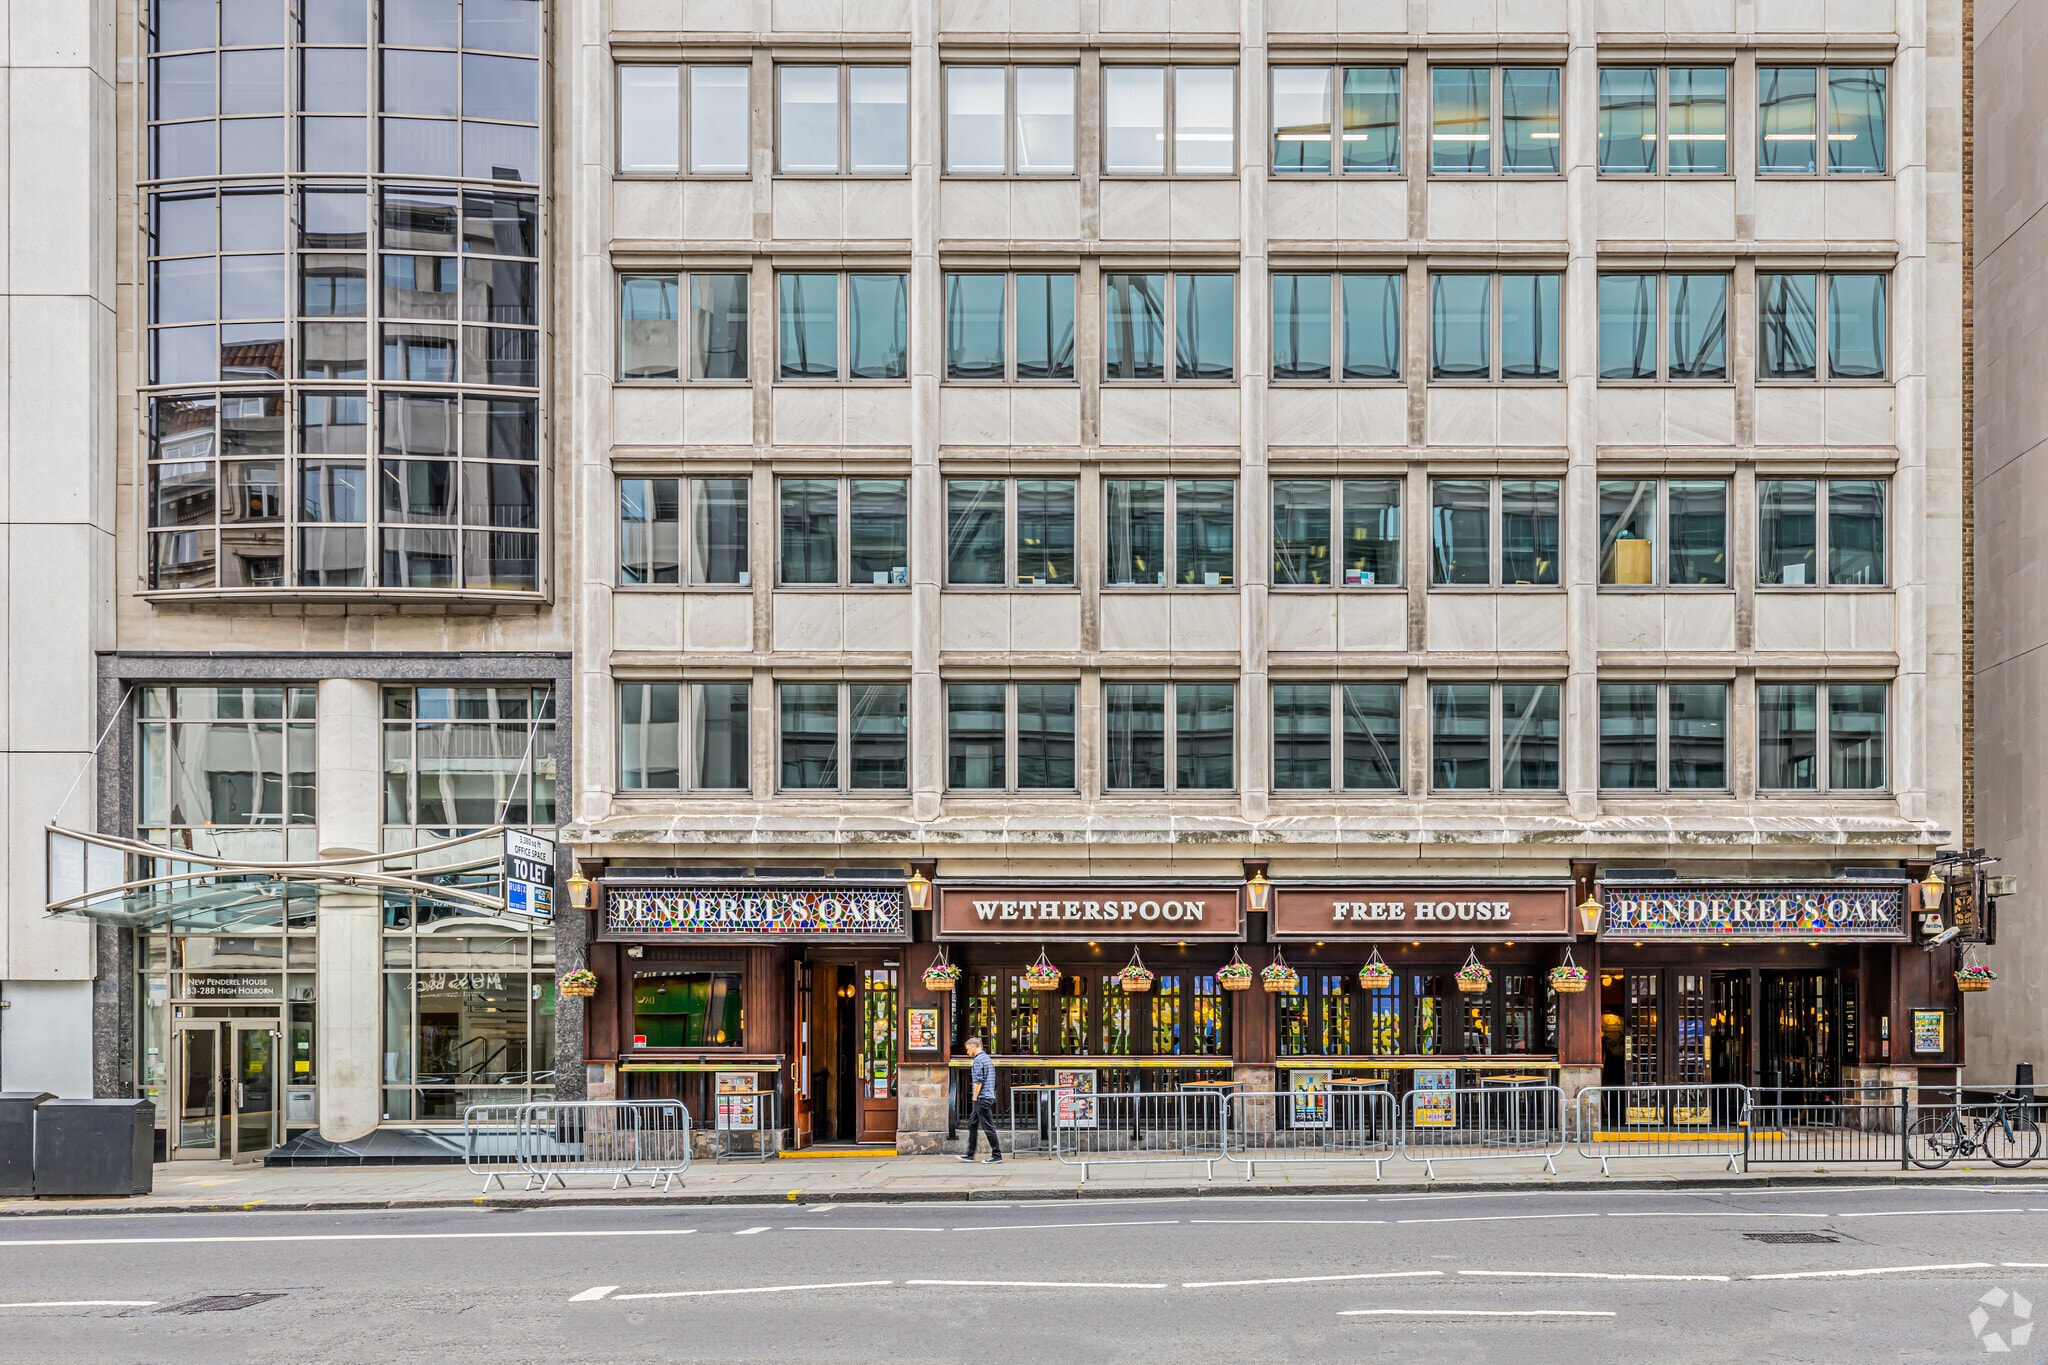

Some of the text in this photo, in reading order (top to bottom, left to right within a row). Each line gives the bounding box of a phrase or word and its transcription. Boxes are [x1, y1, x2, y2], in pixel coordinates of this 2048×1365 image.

[514, 845, 546, 861] OFFICE SPACE
[513, 858, 547, 884] TO LET
[618, 895, 891, 922] PENDEREL'S OAK
[972, 900, 1206, 921] WETHERSPOON
[1332, 901, 1512, 921] FREE HOUSE
[1618, 896, 1890, 922] PENDEREL'S OAK
[181, 987, 274, 995] 83-288 HIGH HOLBORN
[187, 978, 267, 986] NEW PENDEREL HOUSE
